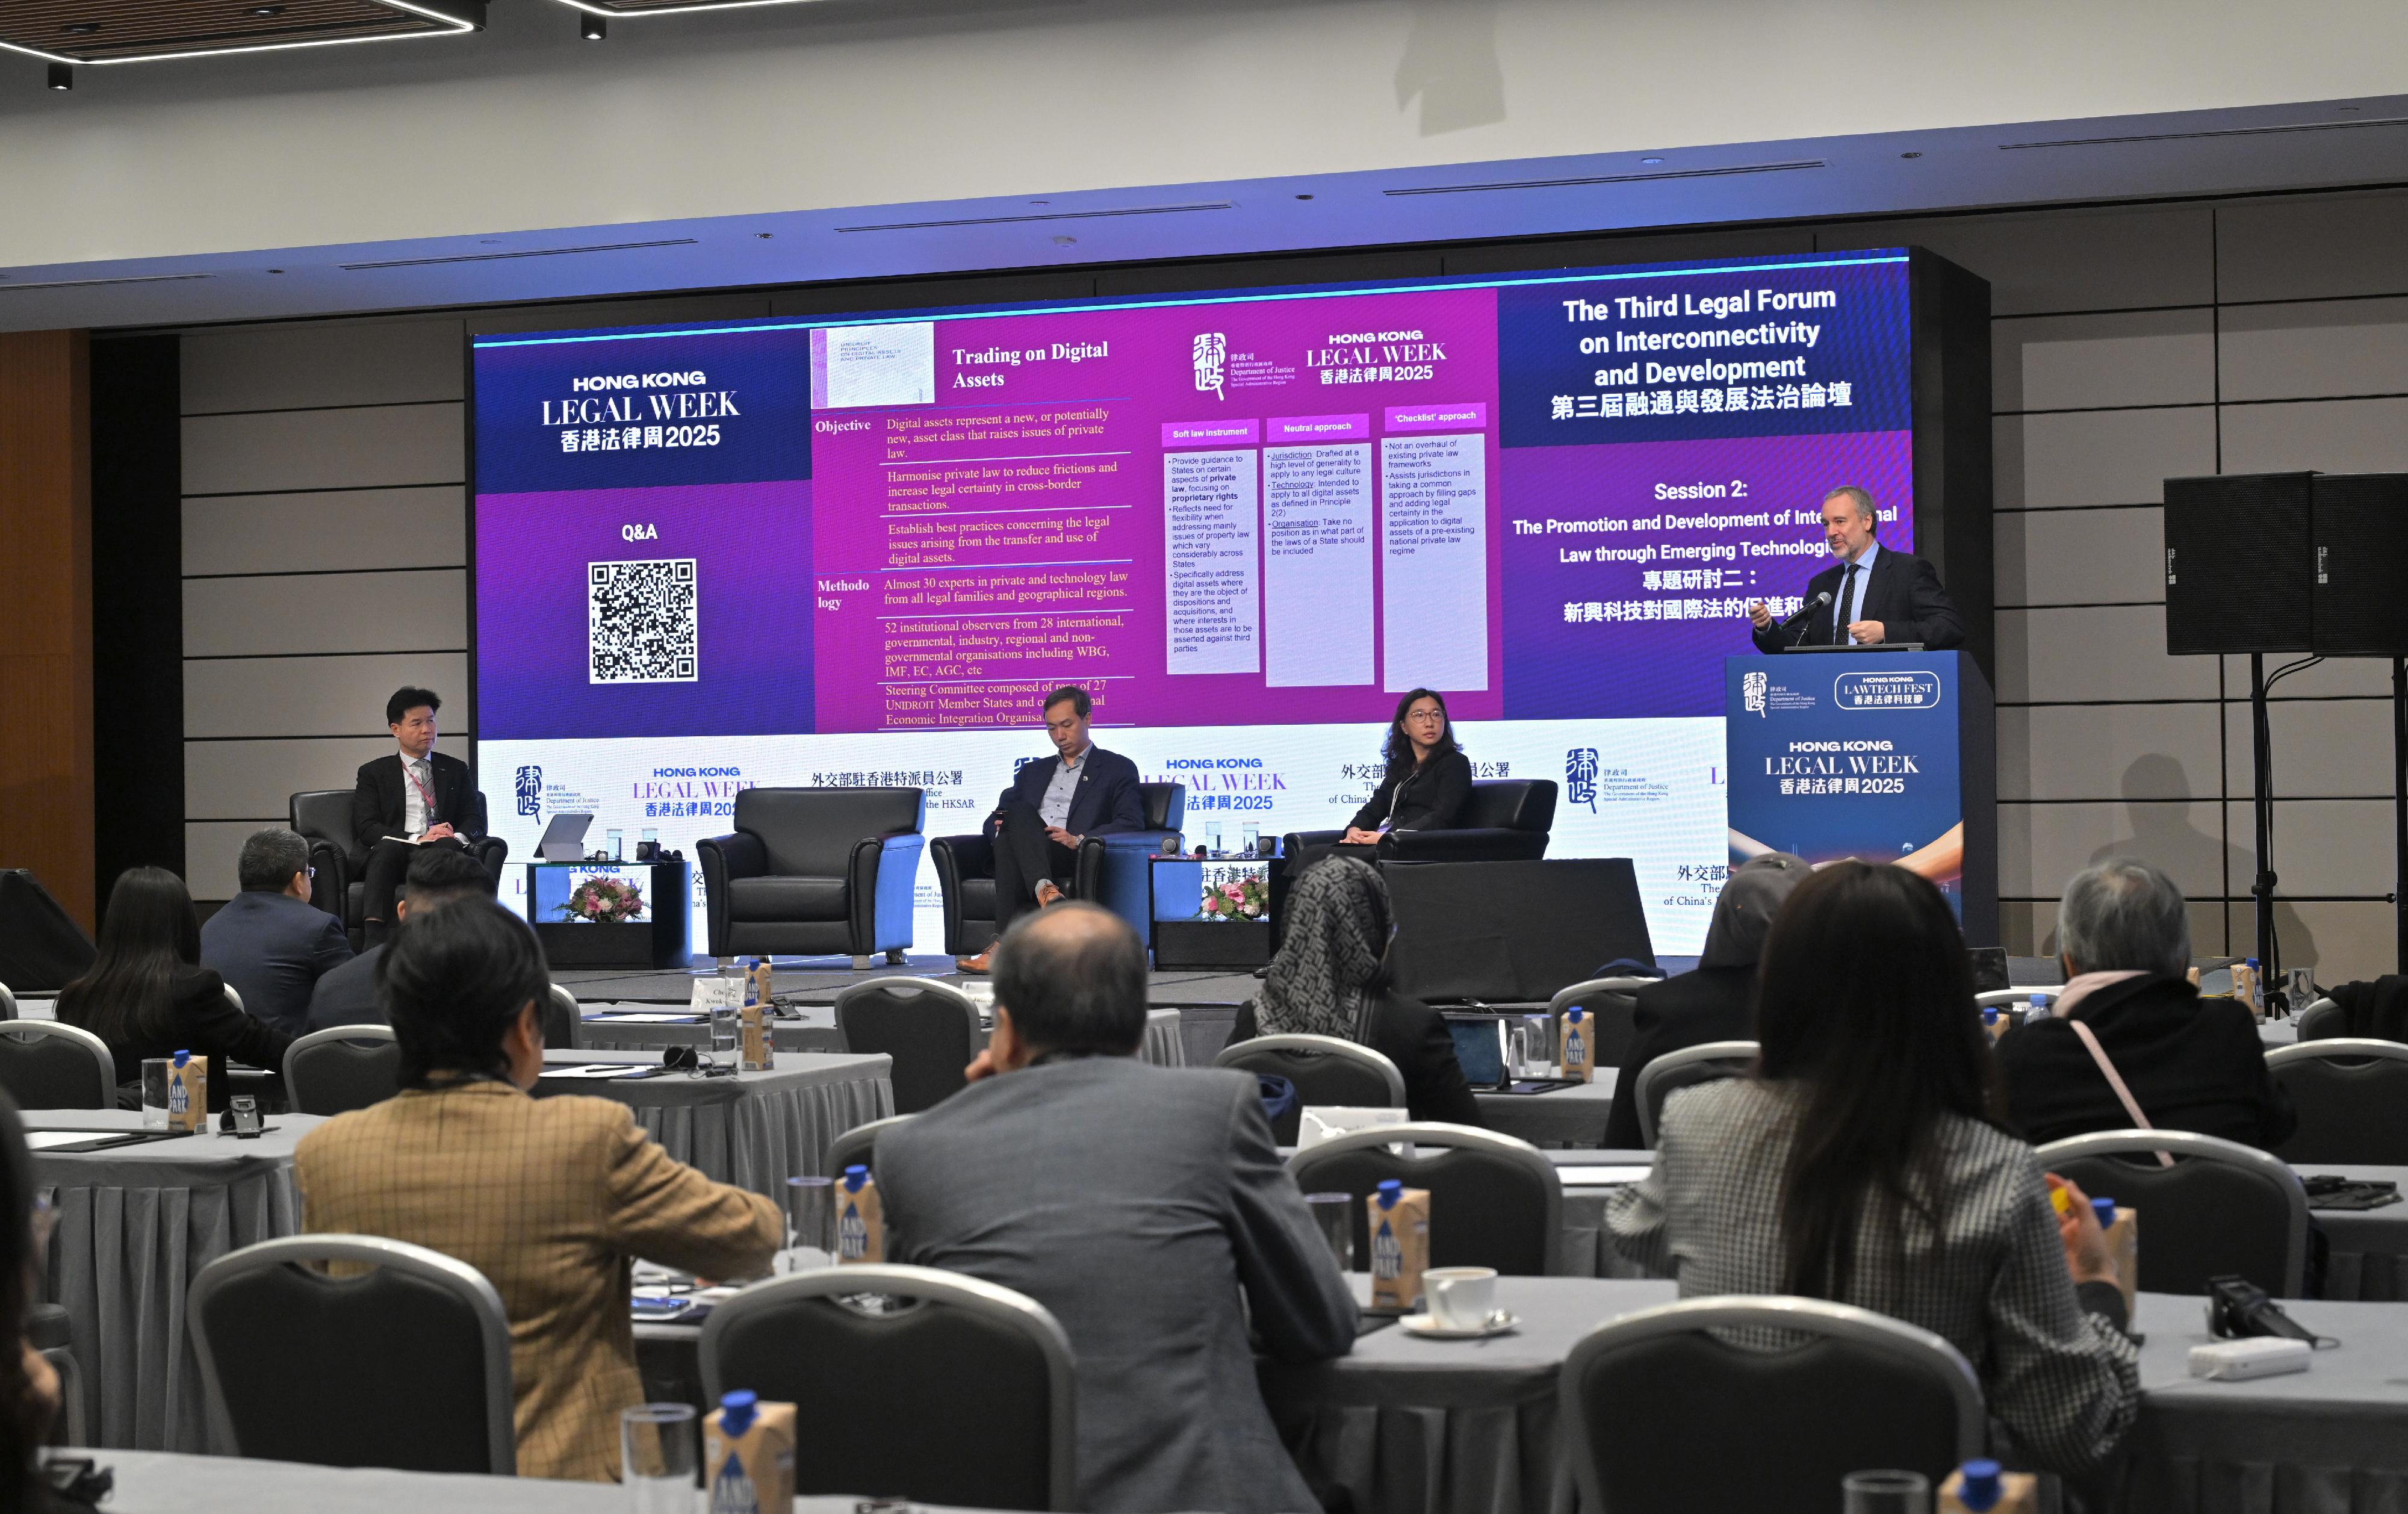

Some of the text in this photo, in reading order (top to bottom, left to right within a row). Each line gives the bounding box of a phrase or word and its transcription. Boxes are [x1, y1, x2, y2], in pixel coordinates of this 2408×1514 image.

[1563, 289, 1835, 322] The Third Legal Forum
[1329, 330, 1423, 344] HONG KONG
[1580, 321, 1820, 354] on Interconnectivity
[952, 341, 1108, 366] Trading on Digital
[1230, 353, 1253, 361] 律政司
[1306, 343, 1447, 367] LEGAL WEEK
[1320, 365, 1433, 384] 香港法律周2025
[1594, 356, 1806, 386] and Development
[573, 371, 706, 391] HONG KONG
[952, 372, 1004, 388] Assets
[542, 391, 740, 425] LEGAL WEEK
[1551, 380, 1852, 420] 第三屆融通與發展法治論壇
[887, 417, 920, 432] Digital
[923, 418, 953, 427] assets
[956, 415, 1002, 428] represent
[1014, 415, 1037, 423] new,
[1054, 408, 1109, 424] potentially
[1395, 411, 1476, 422] 'Checklist' approach
[815, 419, 870, 435] Objective
[913, 433, 937, 442] asset
[940, 430, 965, 441] class
[968, 429, 987, 439] that
[990, 427, 1019, 439] raises
[1022, 427, 1052, 437] issues
[1054, 424, 1067, 435] of
[1068, 424, 1104, 438] private
[1206, 427, 1247, 436] instrument
[1284, 422, 1351, 432] Neutral approach
[560, 424, 720, 452] 香港法律周2025
[887, 448, 907, 459] law.
[1201, 456, 1233, 465] guidance
[1388, 451, 1416, 460] existing
[1419, 450, 1444, 459] private
[1270, 461, 1286, 470] high
[1316, 459, 1351, 468] generality
[1388, 460, 1431, 468] frameworks
[1654, 480, 1747, 500] Session 2:
[1512, 506, 1897, 535] The Promotion and Development of Intenal
[622, 523, 657, 542] Q&A
[1560, 538, 1833, 563] Law through Emerging Technologi
[818, 579, 869, 591] Methodo
[884, 571, 1128, 590] Almost 30 experts in private and technology law
[1642, 568, 1755, 591] 專題研討二：
[818, 597, 842, 610] logy
[1845, 683, 1932, 694] LAWTECH FEST
[1854, 694, 1923, 705] 香港法律科技節
[1789, 740, 1893, 752] HONG KONG
[1166, 758, 1262, 769] HONG KONG
[1766, 755, 1919, 775] LEGAL WEEK
[653, 767, 740, 777] HONG KONG
[810, 770, 963, 788] 外交部駐香港特派員公署
[1220, 773, 1287, 790] WEEK
[1780, 778, 1904, 794] 香港法律周2025
[632, 781, 698, 799] LEGAL
[926, 788, 942, 797] ffice
[942, 799, 975, 808] HKSAR
[1187, 795, 1273, 810] 法律周2025
[1329, 794, 1371, 804] of China'
[645, 801, 735, 817] 香港法律周20
[1677, 865, 1728, 881] 外交部
[1701, 884, 1720, 892] The
[1664, 896, 1711, 905] of China's
[746, 982, 759, 992] LAND
[169, 1085, 187, 1098] LAND
[170, 1099, 187, 1112] PARK
